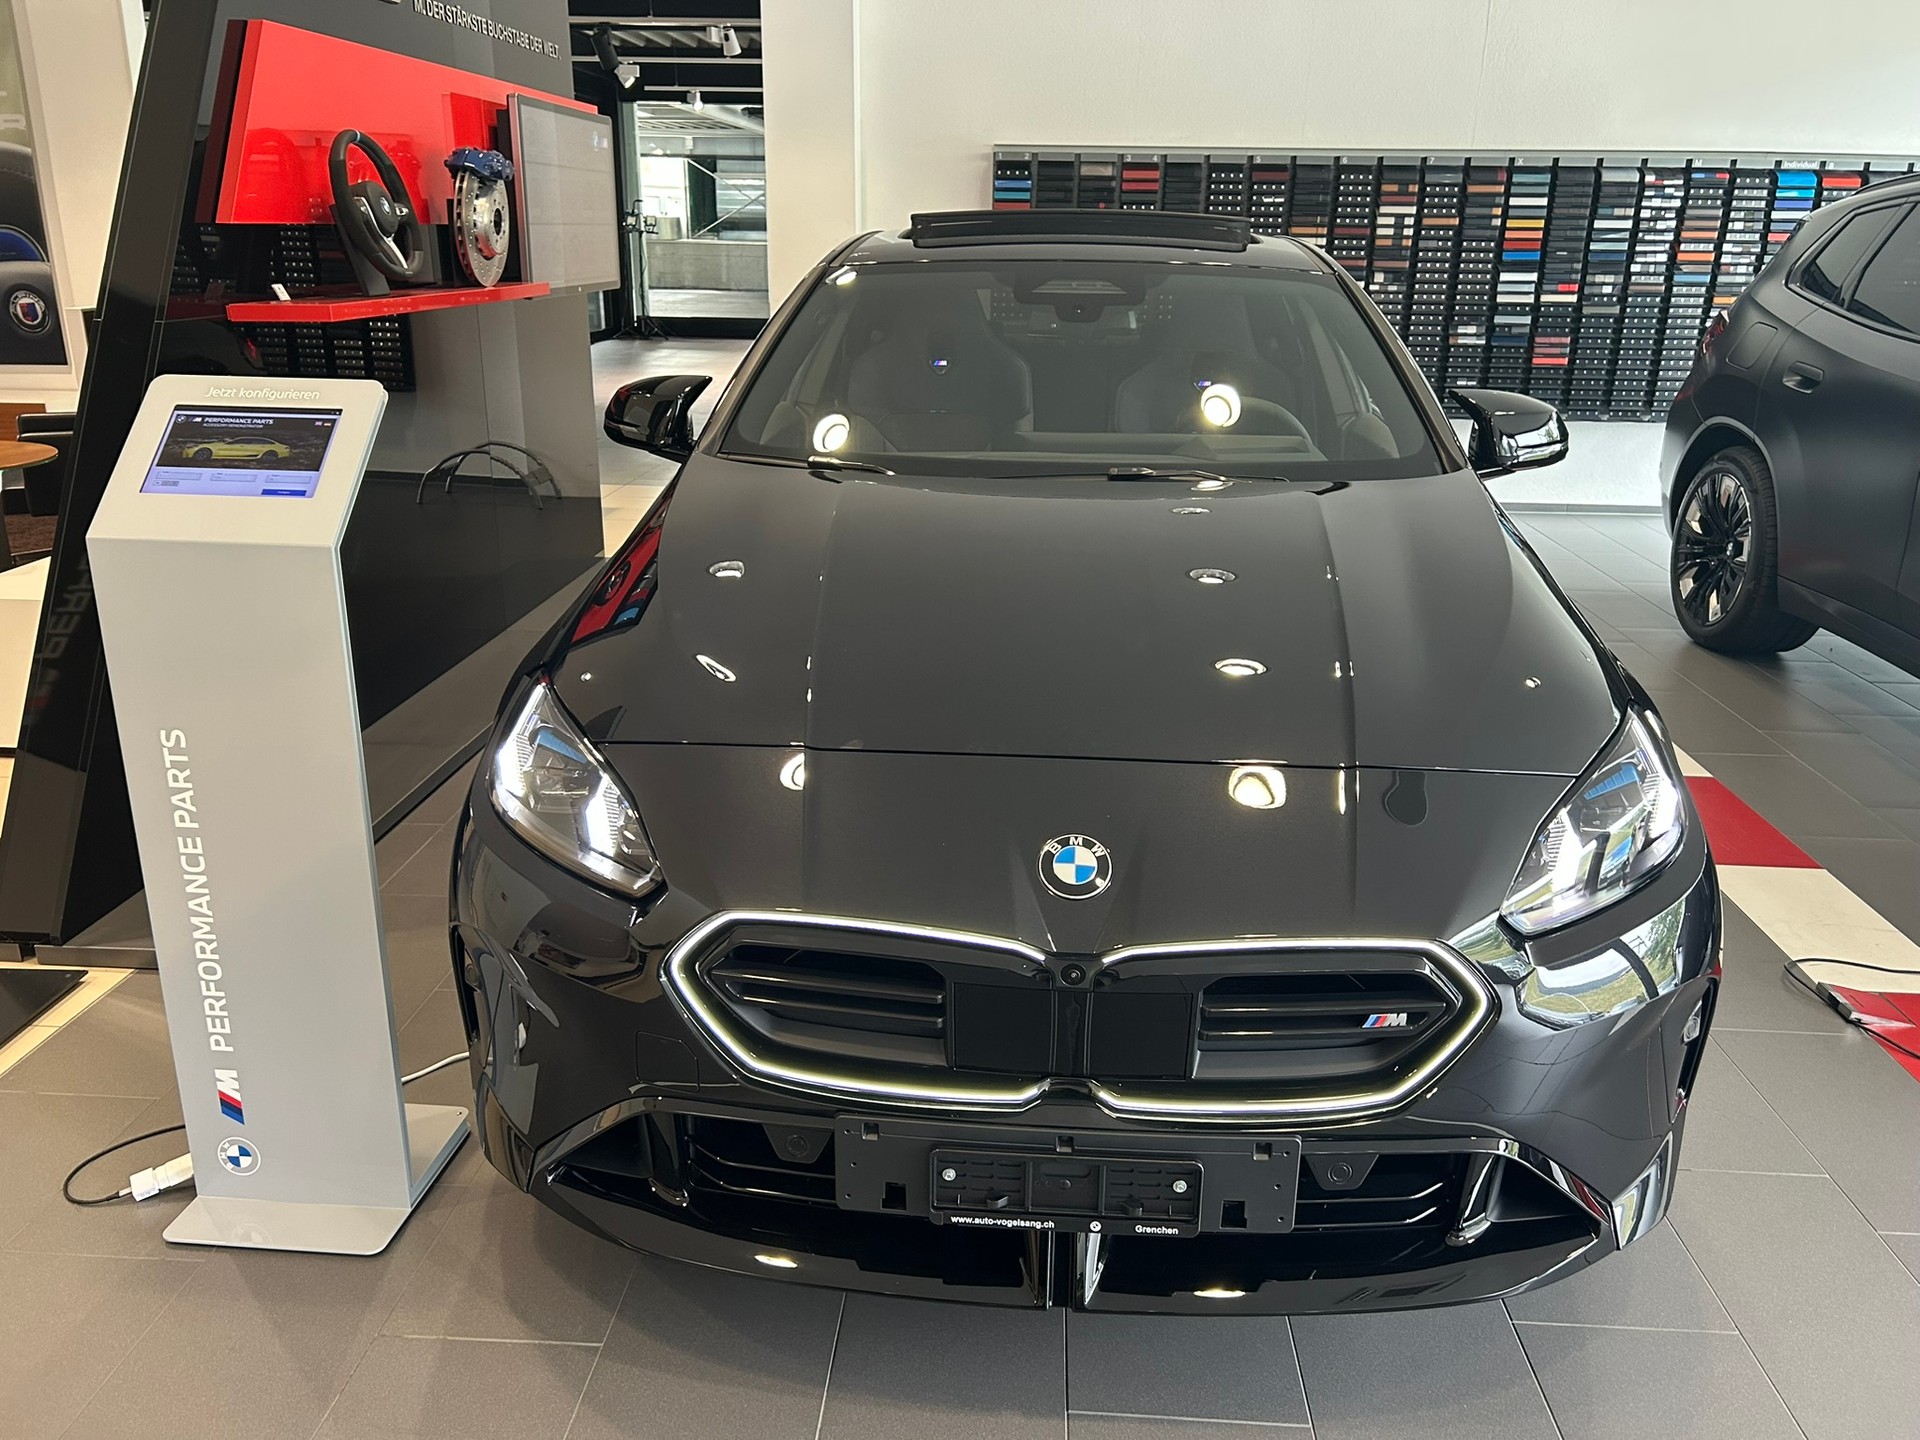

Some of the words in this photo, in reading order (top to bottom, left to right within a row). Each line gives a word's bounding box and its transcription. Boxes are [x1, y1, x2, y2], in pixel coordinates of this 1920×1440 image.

[412, 0, 426, 16] M.
[426, 0, 446, 21] DER
[445, 5, 488, 35] STÄRKSTE
[488, 20, 530, 49] BUCHSTABE
[529, 35, 543, 54] DER
[543, 41, 562, 60] WELT.
[1126, 154, 1132, 162] 3
[1256, 155, 1262, 163] 5
[1342, 156, 1348, 164] 6
[1429, 157, 1435, 165] 7
[1517, 158, 1524, 166] X
[1784, 160, 1818, 169] Individual
[205, 386, 236, 398] Jetzt
[239, 387, 320, 400] konfigurieren
[160, 728, 200, 829] PARTS
[177, 836, 234, 1052] PERFORMANCE
[950, 1215, 1055, 1229] www.auto-vogelsang.ch
[1135, 1224, 1179, 1236] Grenchen
